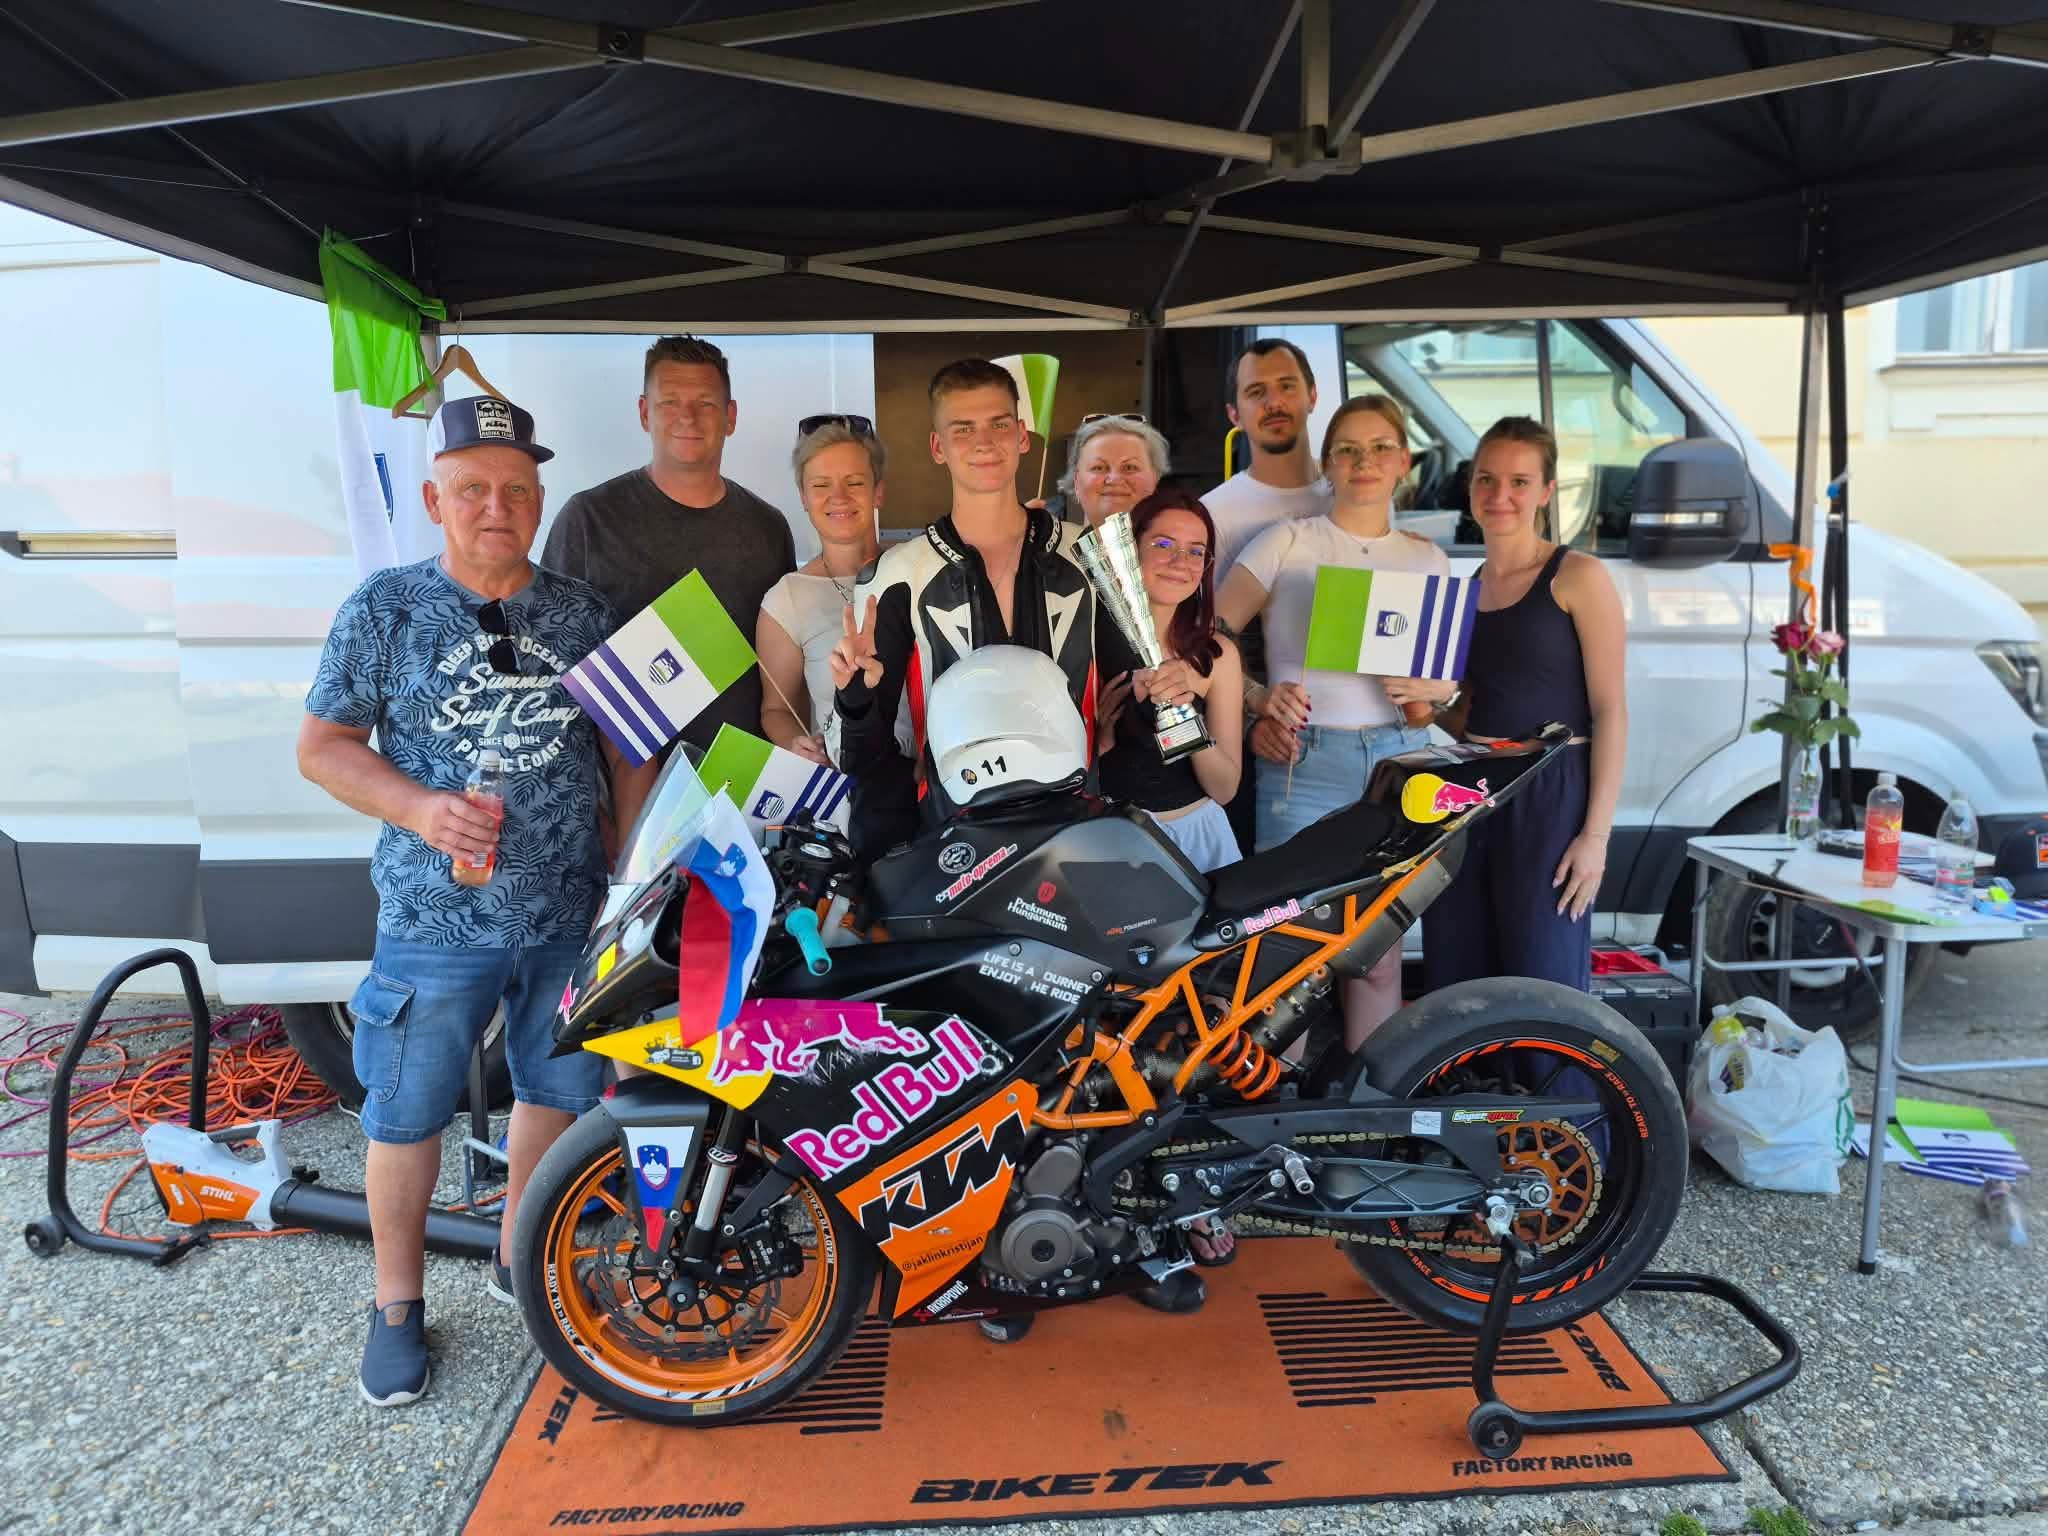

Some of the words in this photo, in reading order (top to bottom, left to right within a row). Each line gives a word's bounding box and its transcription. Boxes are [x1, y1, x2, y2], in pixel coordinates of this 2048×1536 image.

[437, 641, 473, 676] DEEP
[519, 636, 568, 673] OCEAN
[458, 663, 561, 695] Summer
[431, 694, 513, 738] Surf
[511, 691, 582, 730] Camp
[455, 738, 514, 772] PAIC
[518, 736, 565, 773] COAST
[478, 737, 502, 746] SINCE
[981, 755, 1007, 777] 11
[971, 846, 1009, 881] oprema
[1007, 901, 1068, 932] Hungarikum
[1015, 897, 1067, 923] Prekmurec
[1243, 908, 1275, 935] Red
[1270, 898, 1301, 924] Bull
[979, 964, 1022, 985] ENJOY
[1050, 987, 1081, 1005] RIDE
[983, 952, 1010, 968] LIFE
[1011, 960, 1025, 972] IS
[1025, 967, 1035, 977] A
[1042, 971, 1093, 995] OURNEY
[782, 1081, 904, 1182] Red
[873, 1016, 986, 1124] Bull
[200, 1185, 236, 1203] STIHL
[858, 1109, 1027, 1246] KTM
[1453, 1456, 1548, 1476] FACTORY
[1551, 1452, 1632, 1471] RACING
[550, 1506, 657, 1527] FACTORY
[653, 1501, 745, 1521] RACING
